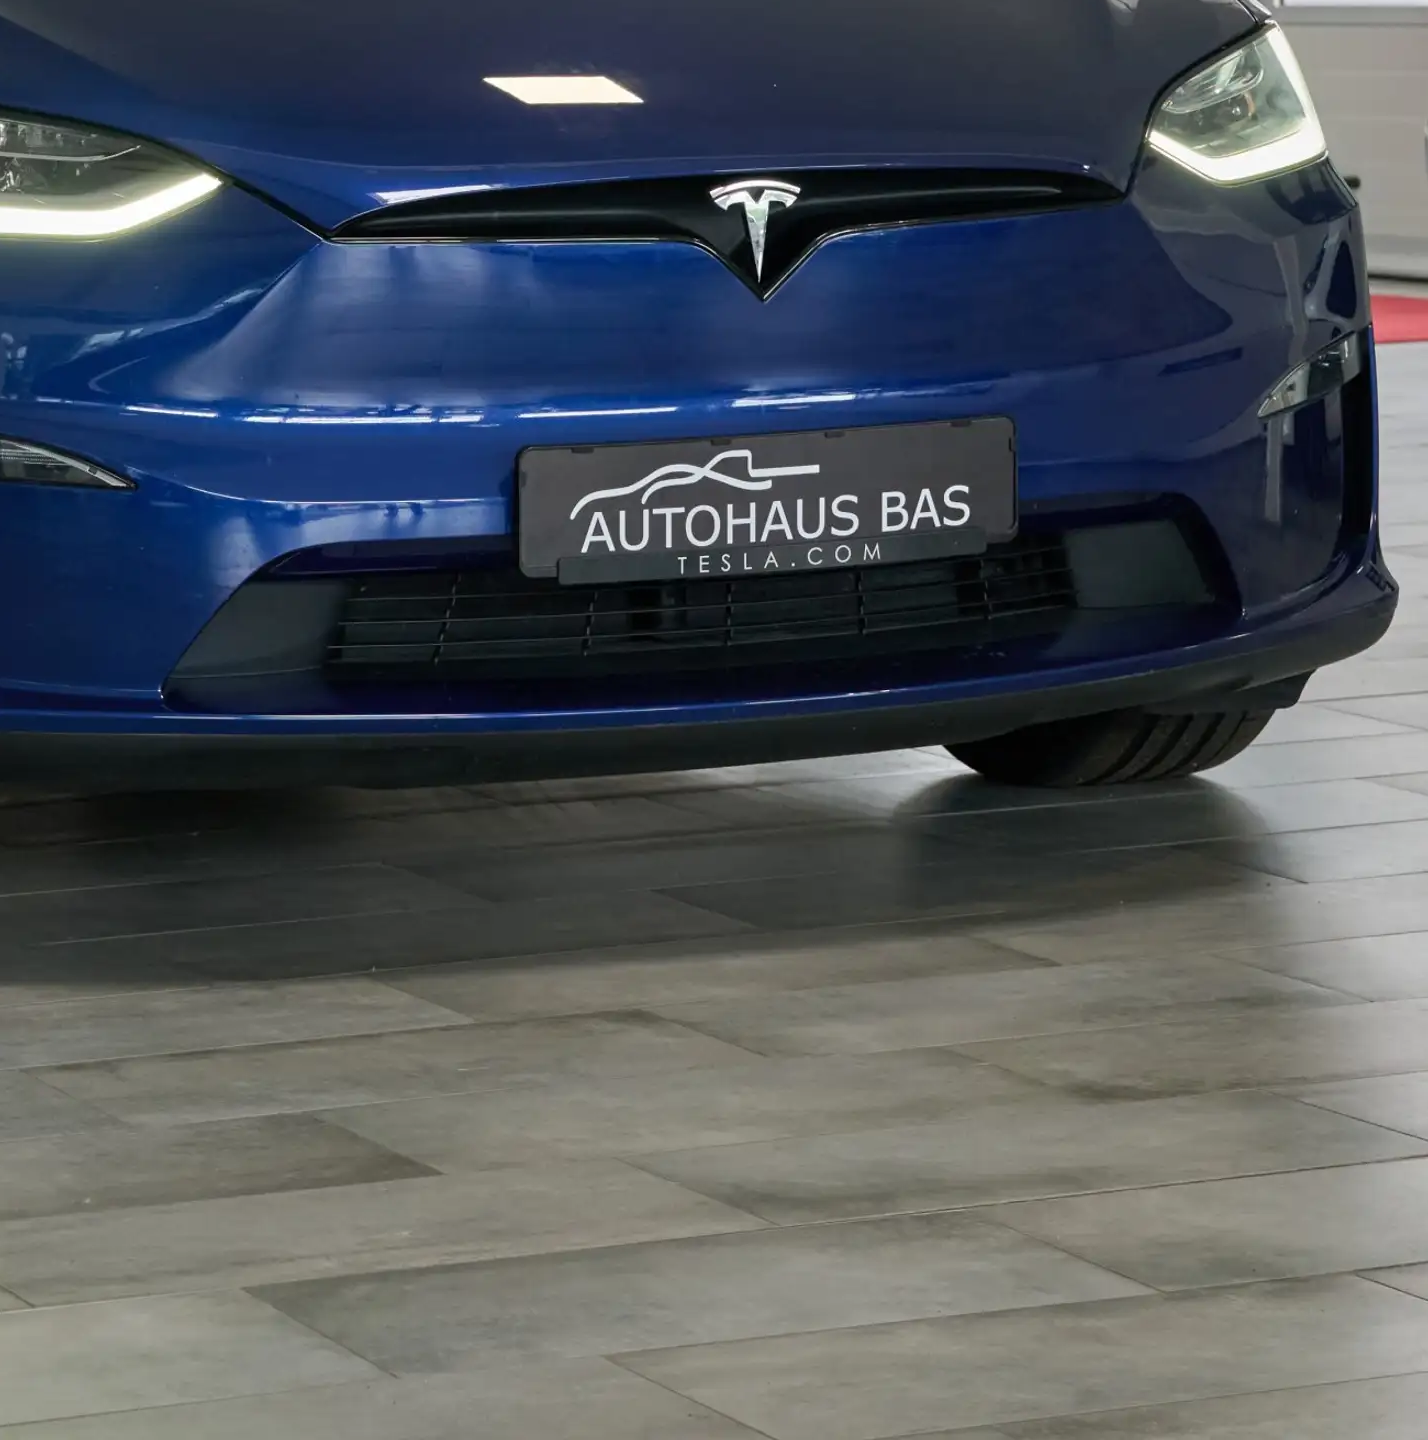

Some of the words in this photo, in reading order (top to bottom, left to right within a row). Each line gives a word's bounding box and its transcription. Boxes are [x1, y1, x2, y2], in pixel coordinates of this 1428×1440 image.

[580, 494, 860, 554] AUTOHAUS
[881, 484, 971, 533] BAS
[677, 542, 882, 575] TESLA.COM
